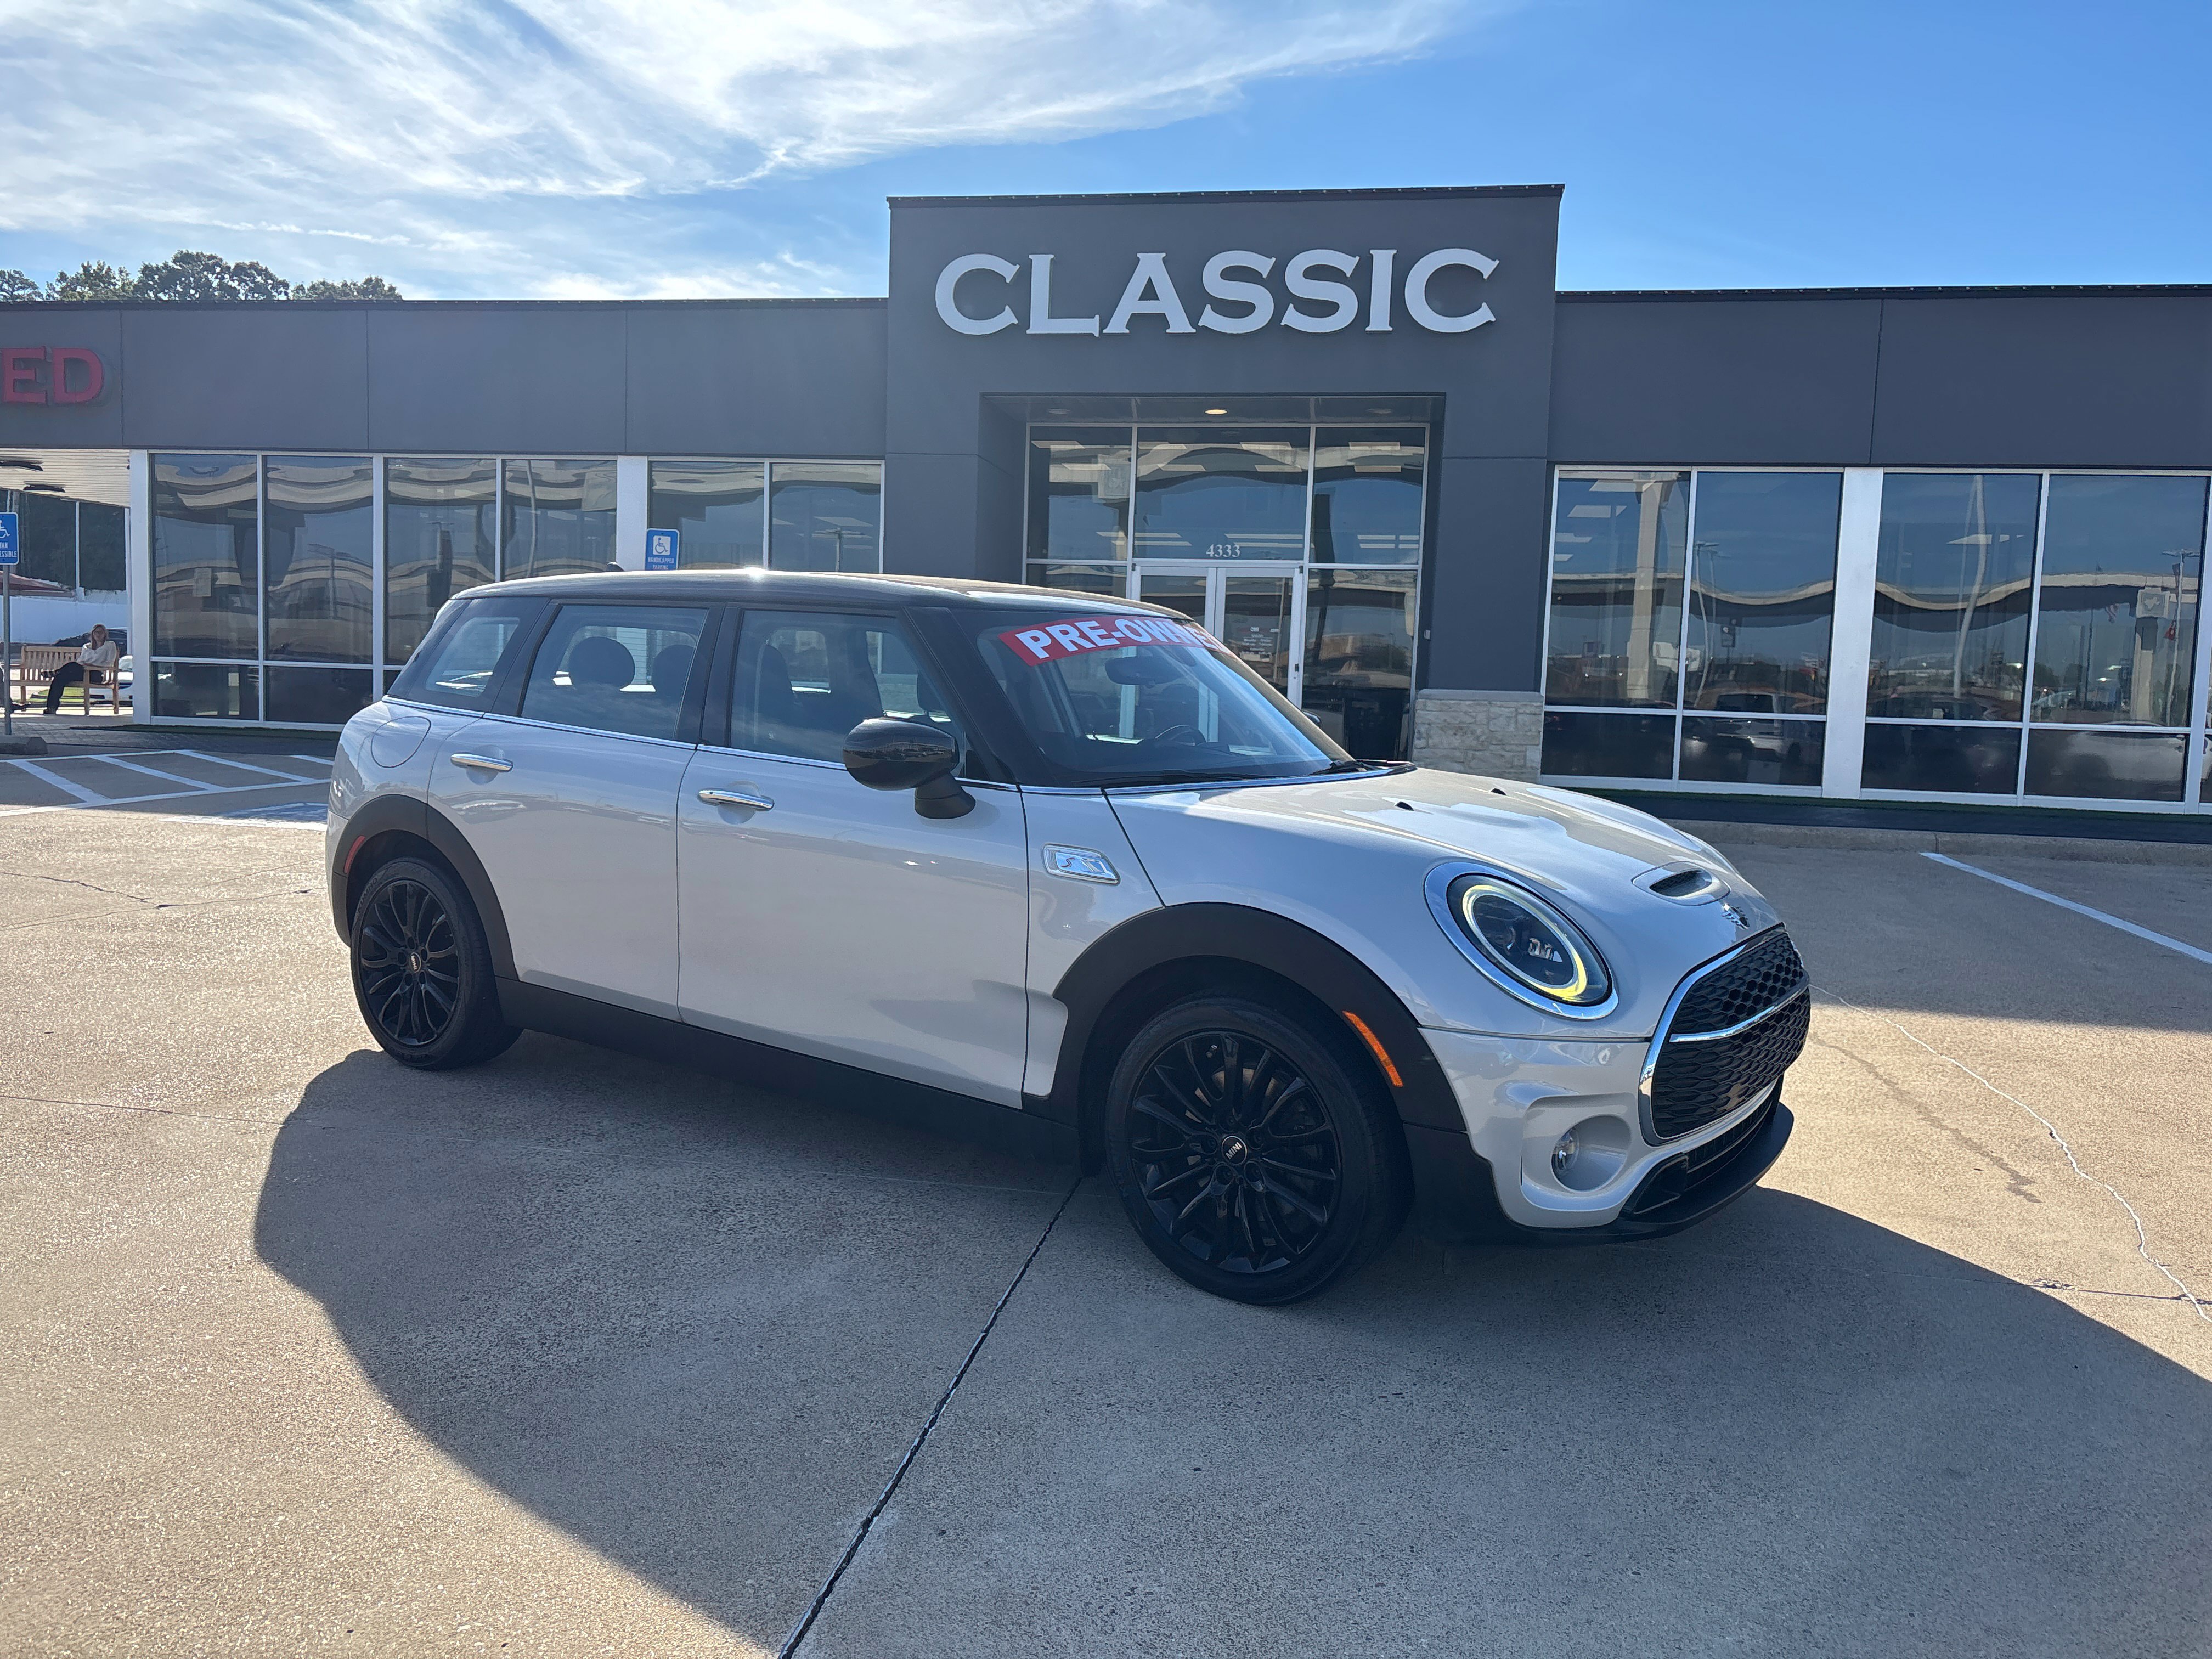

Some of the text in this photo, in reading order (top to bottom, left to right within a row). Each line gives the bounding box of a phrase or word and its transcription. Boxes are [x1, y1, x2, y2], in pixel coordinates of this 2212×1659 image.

[935, 249, 1500, 337] CLASSIC
[1206, 544, 1240, 557] 4333
[1226, 1142, 1242, 1159] MINI
